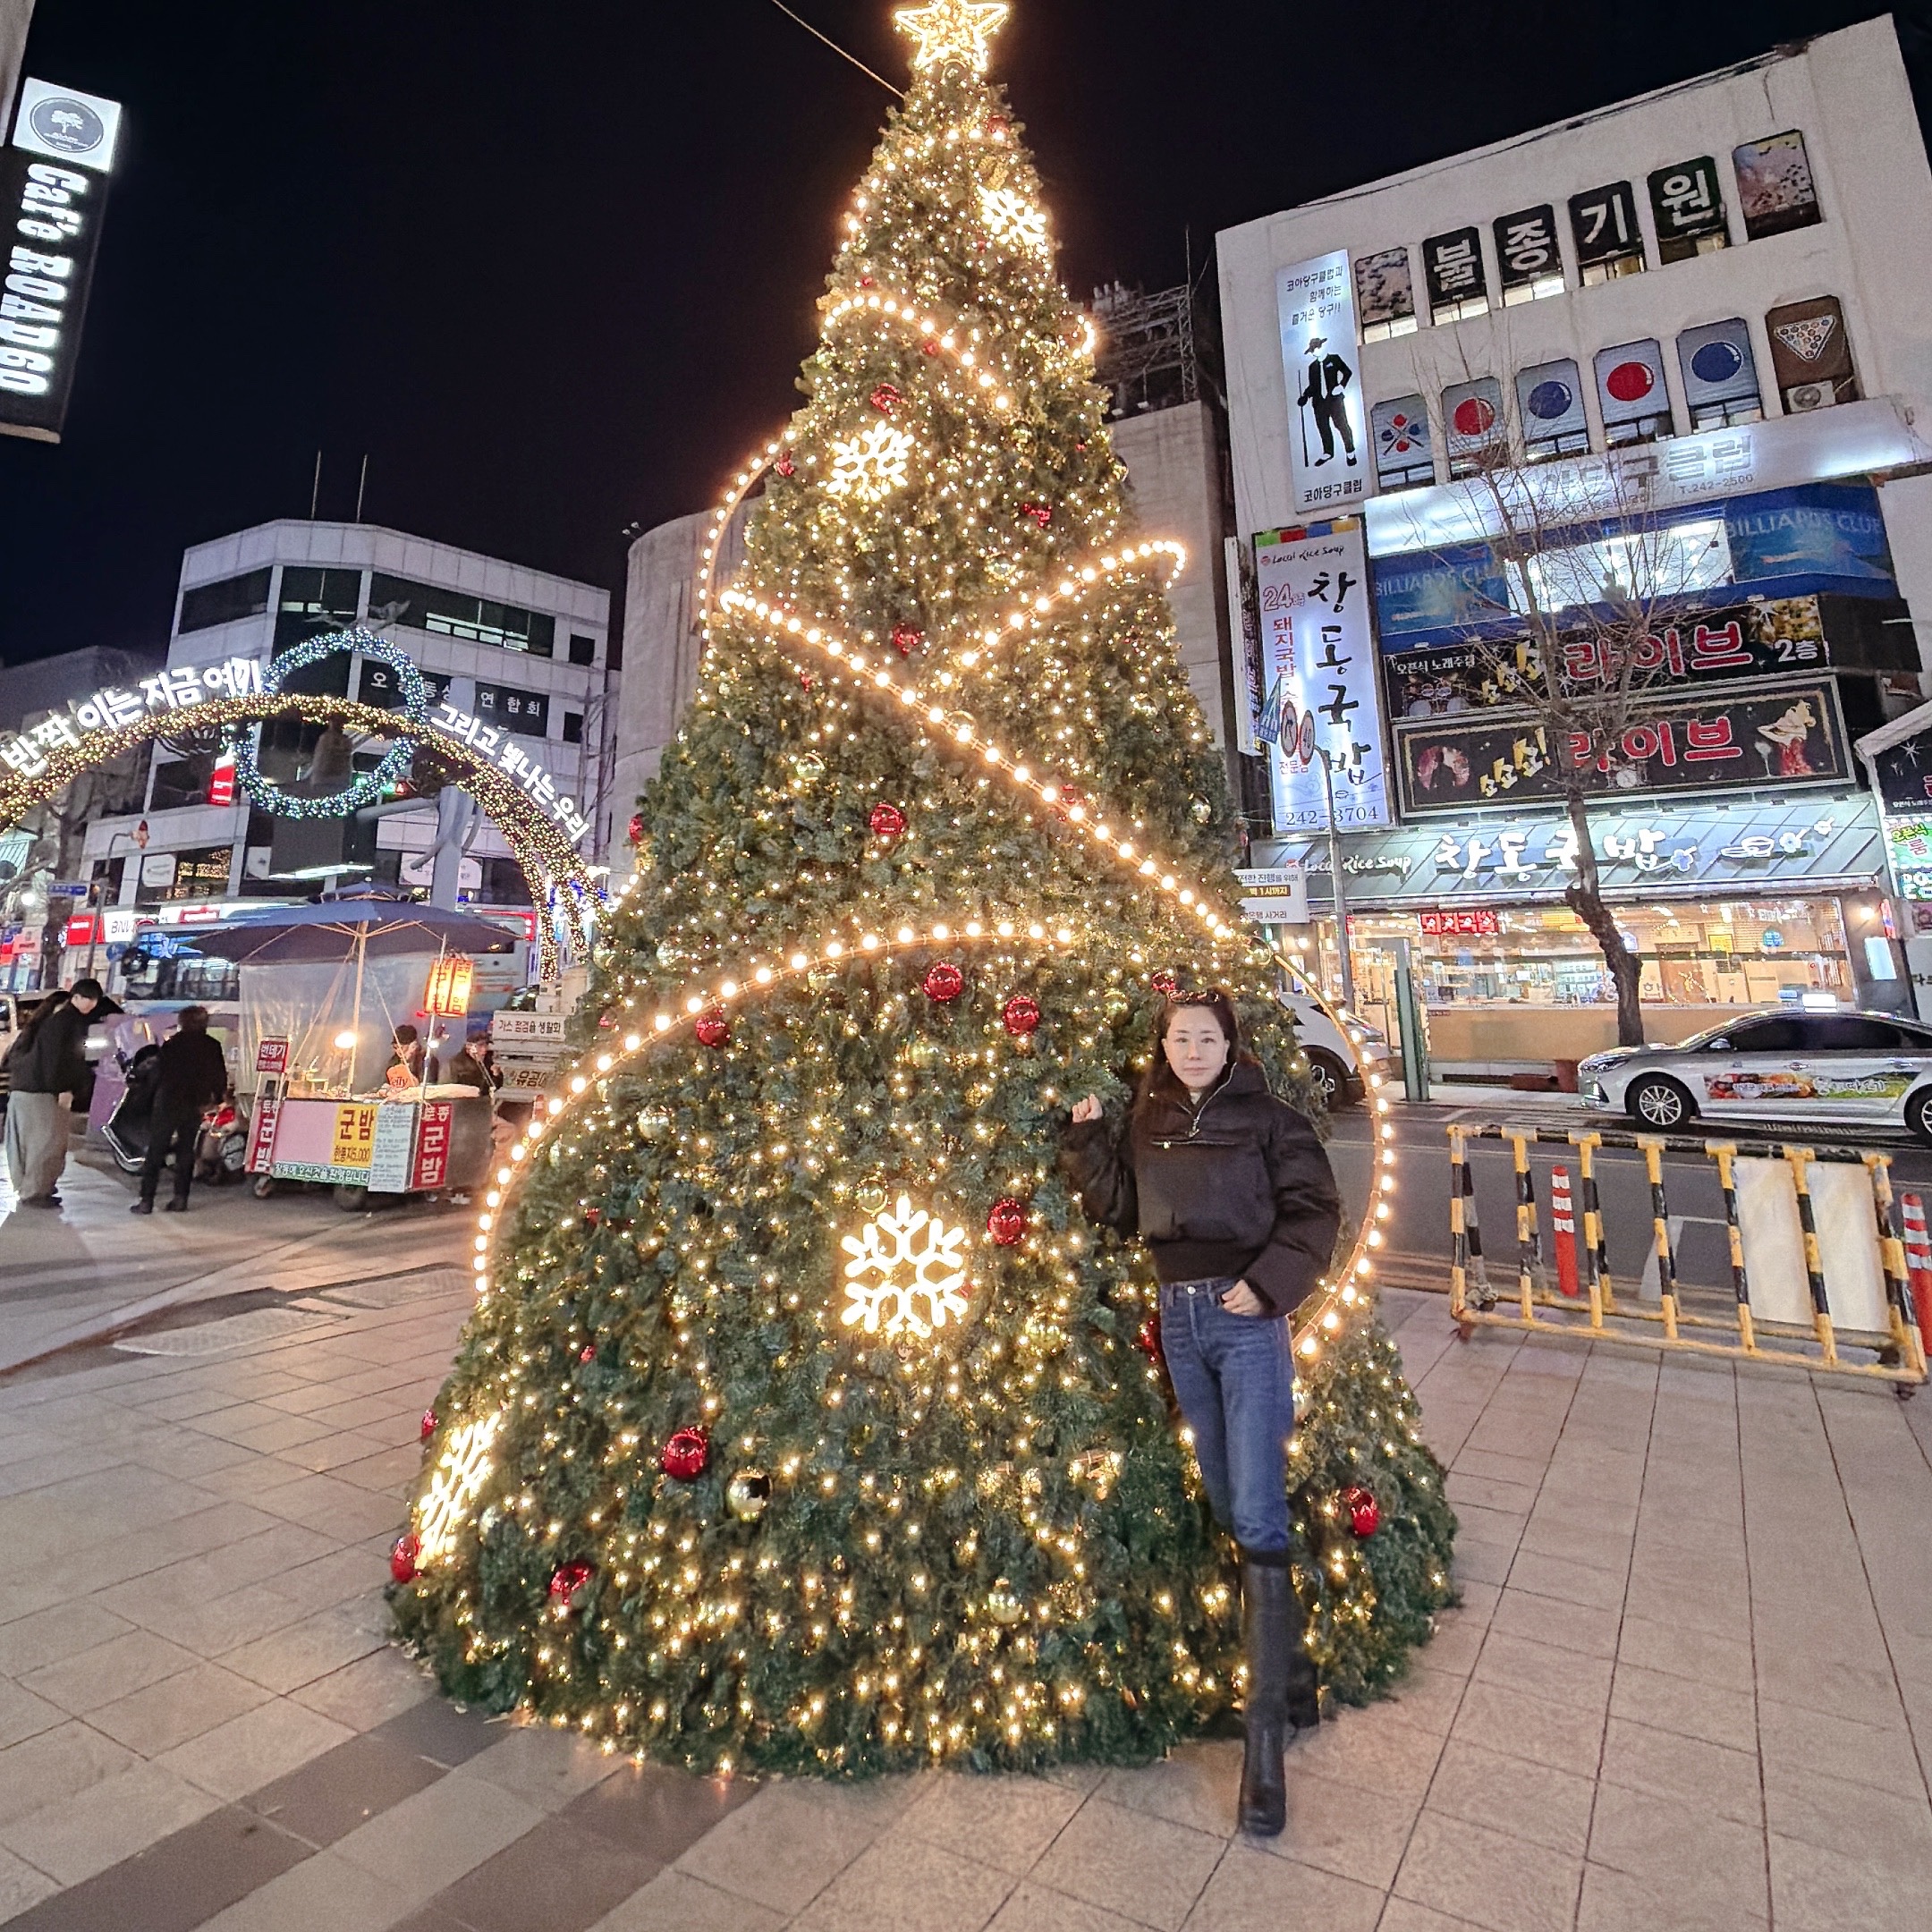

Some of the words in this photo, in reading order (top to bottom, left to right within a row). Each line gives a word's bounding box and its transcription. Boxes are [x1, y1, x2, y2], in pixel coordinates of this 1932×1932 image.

[1286, 266, 1343, 292] 코아당구클럽과
[1309, 284, 1342, 303] 함께하는
[1292, 307, 1315, 326] 즐거운
[1318, 301, 1341, 318] 당구!!
[1303, 479, 1363, 503] 코아당구클럽
[1273, 552, 1296, 564] Local
[1323, 545, 1344, 556] Soup
[1774, 638, 1818, 663] 2층
[138, 665, 202, 709] 지금
[430, 702, 501, 757] 그리고
[497, 741, 556, 805] 빛나는
[551, 796, 590, 843] 우리
[1285, 806, 1379, 826] 242-3704
[1343, 854, 1374, 875] Rice
[1376, 854, 1412, 874] Soup
[1265, 911, 1287, 919] 사거리
[499, 1020, 513, 1032] 가스
[340, 1107, 375, 1141] 군밤
[420, 1125, 445, 1184] 군밤
